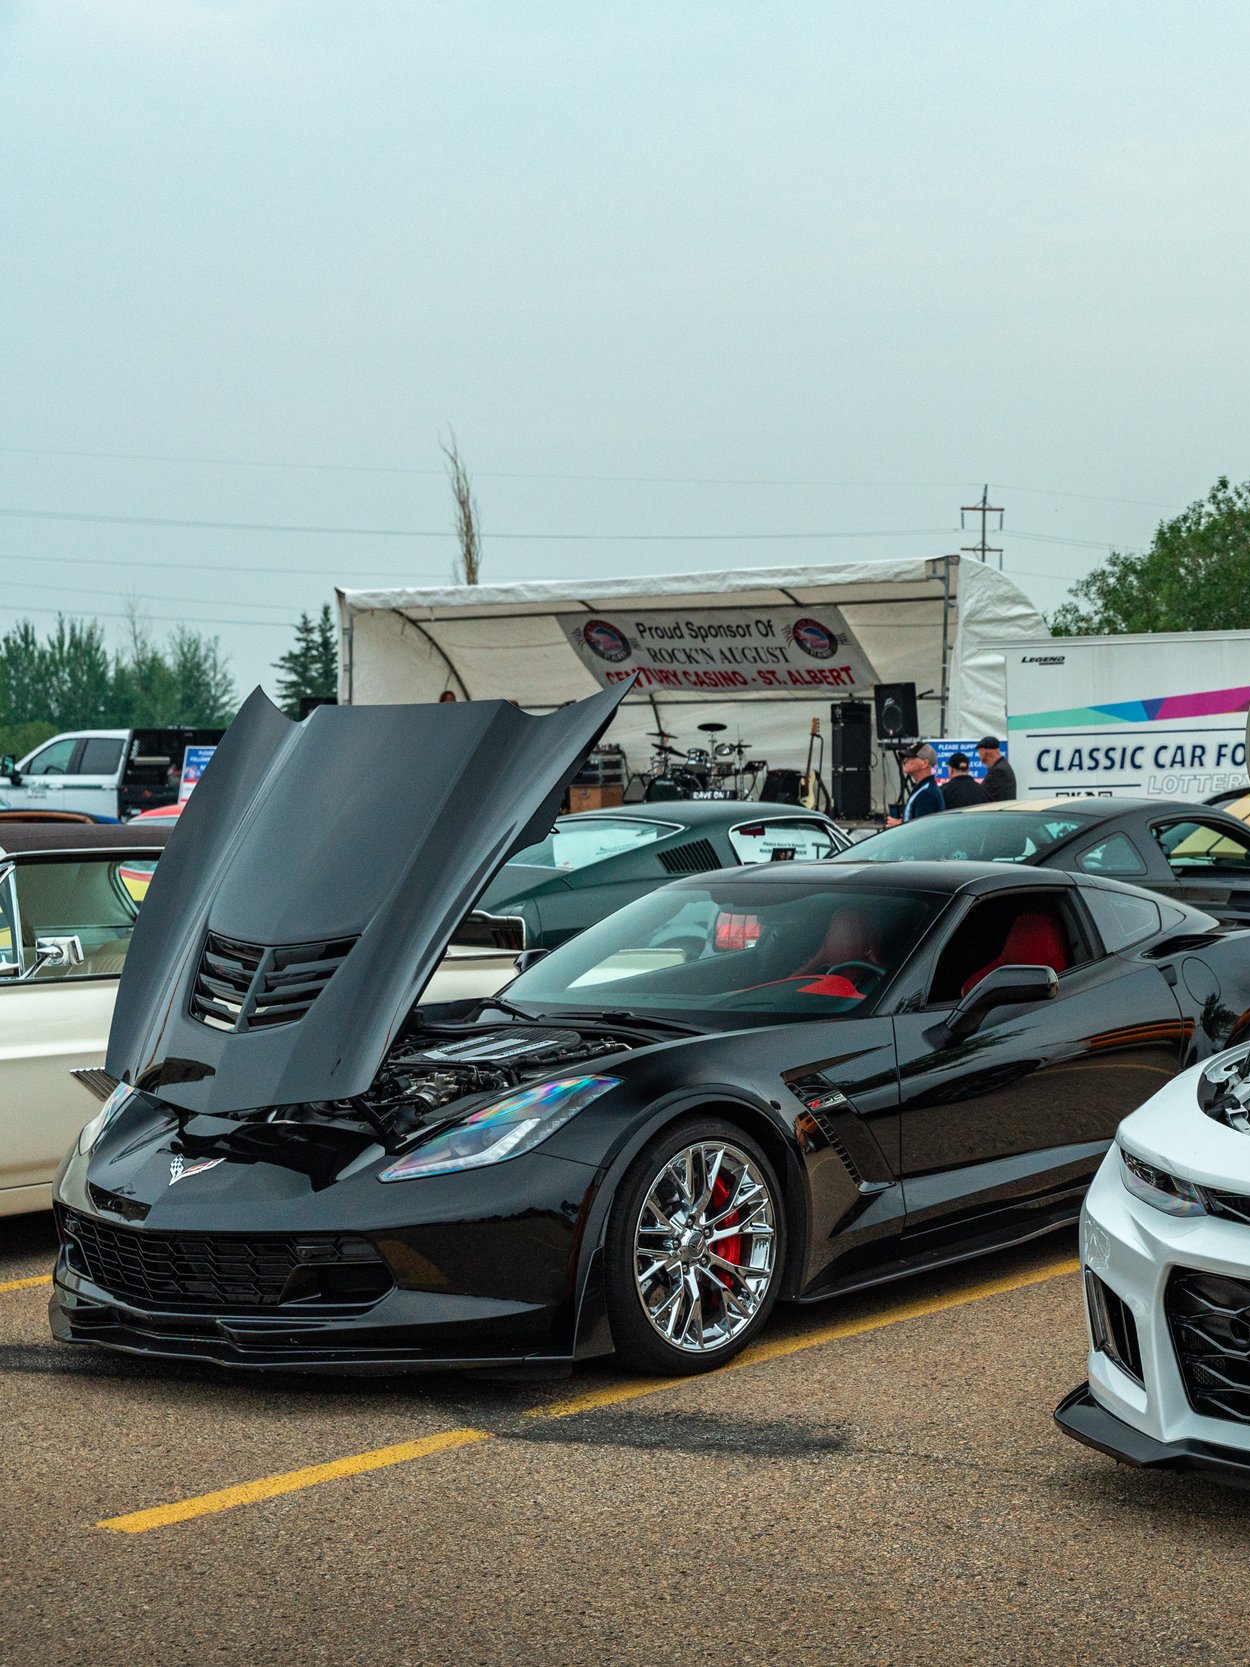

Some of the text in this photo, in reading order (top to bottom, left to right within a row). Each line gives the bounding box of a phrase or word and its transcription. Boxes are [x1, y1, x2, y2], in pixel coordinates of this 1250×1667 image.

[635, 621, 685, 641] Proud
[685, 620, 752, 643] Sponsor
[755, 619, 777, 639] Of
[646, 645, 790, 665] ROCK'N AUGUST
[682, 670, 749, 688] CASINO
[757, 669, 788, 687] ST.
[786, 665, 857, 687] ALBERT
[1036, 742, 1247, 772] CLASSIC CAR FO
[1147, 773, 1250, 795] LOTTER
